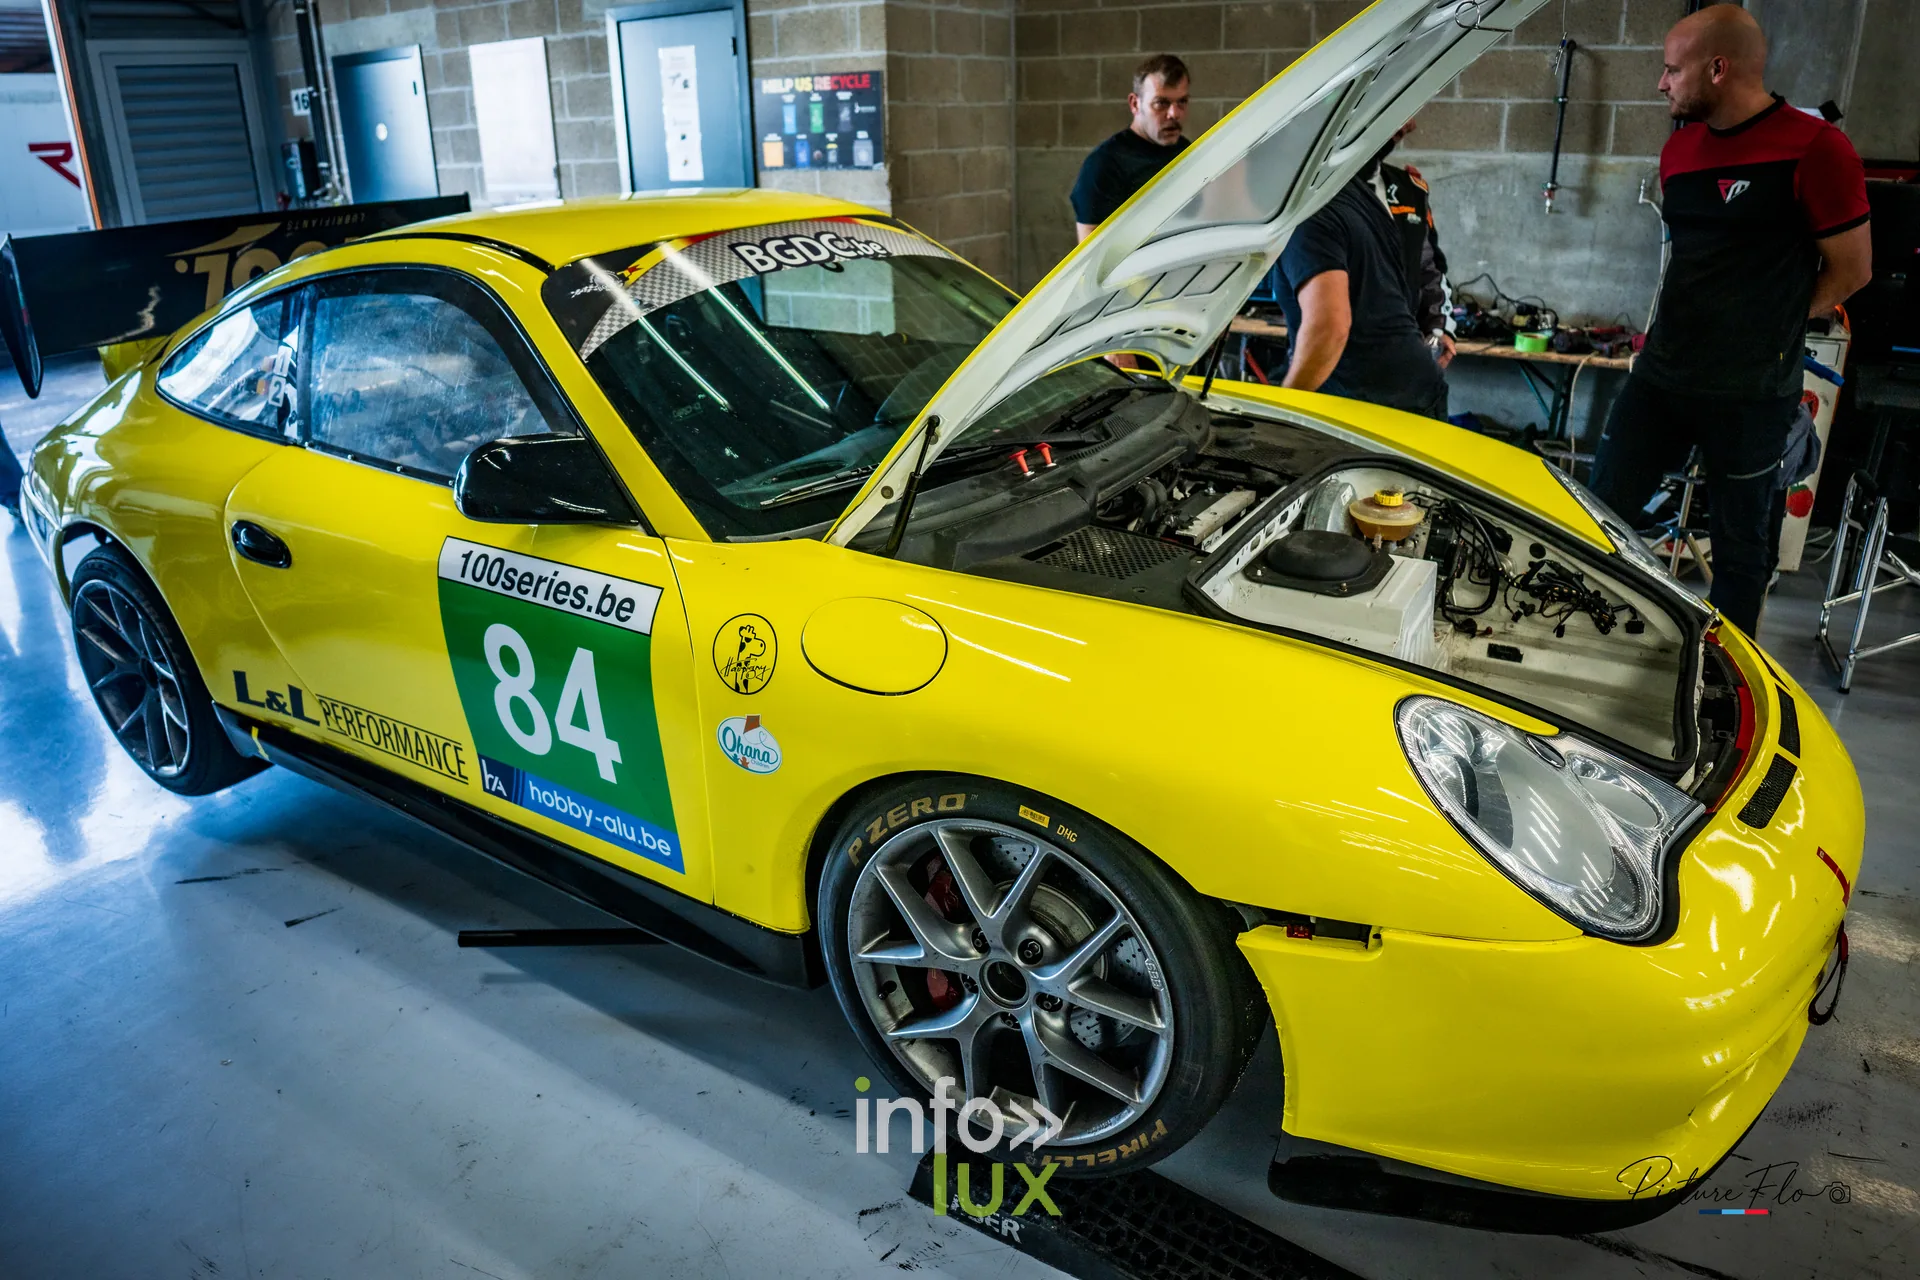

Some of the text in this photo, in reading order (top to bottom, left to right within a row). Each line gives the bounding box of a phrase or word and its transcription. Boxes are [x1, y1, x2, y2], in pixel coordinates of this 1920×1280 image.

[294, 94, 310, 110] 16
[762, 74, 870, 93] HELP US RECYCLE
[460, 549, 636, 623] 100series.be
[232, 669, 469, 781] L&L PERFORMANCE
[483, 622, 622, 785] 84
[722, 726, 776, 765] Ohana
[528, 779, 672, 857] hobby-alu.be
[848, 836, 863, 867] P
[865, 793, 966, 845] ZERO
[1056, 824, 1078, 843] DHG
[1041, 1118, 1169, 1168] PIRELLI
